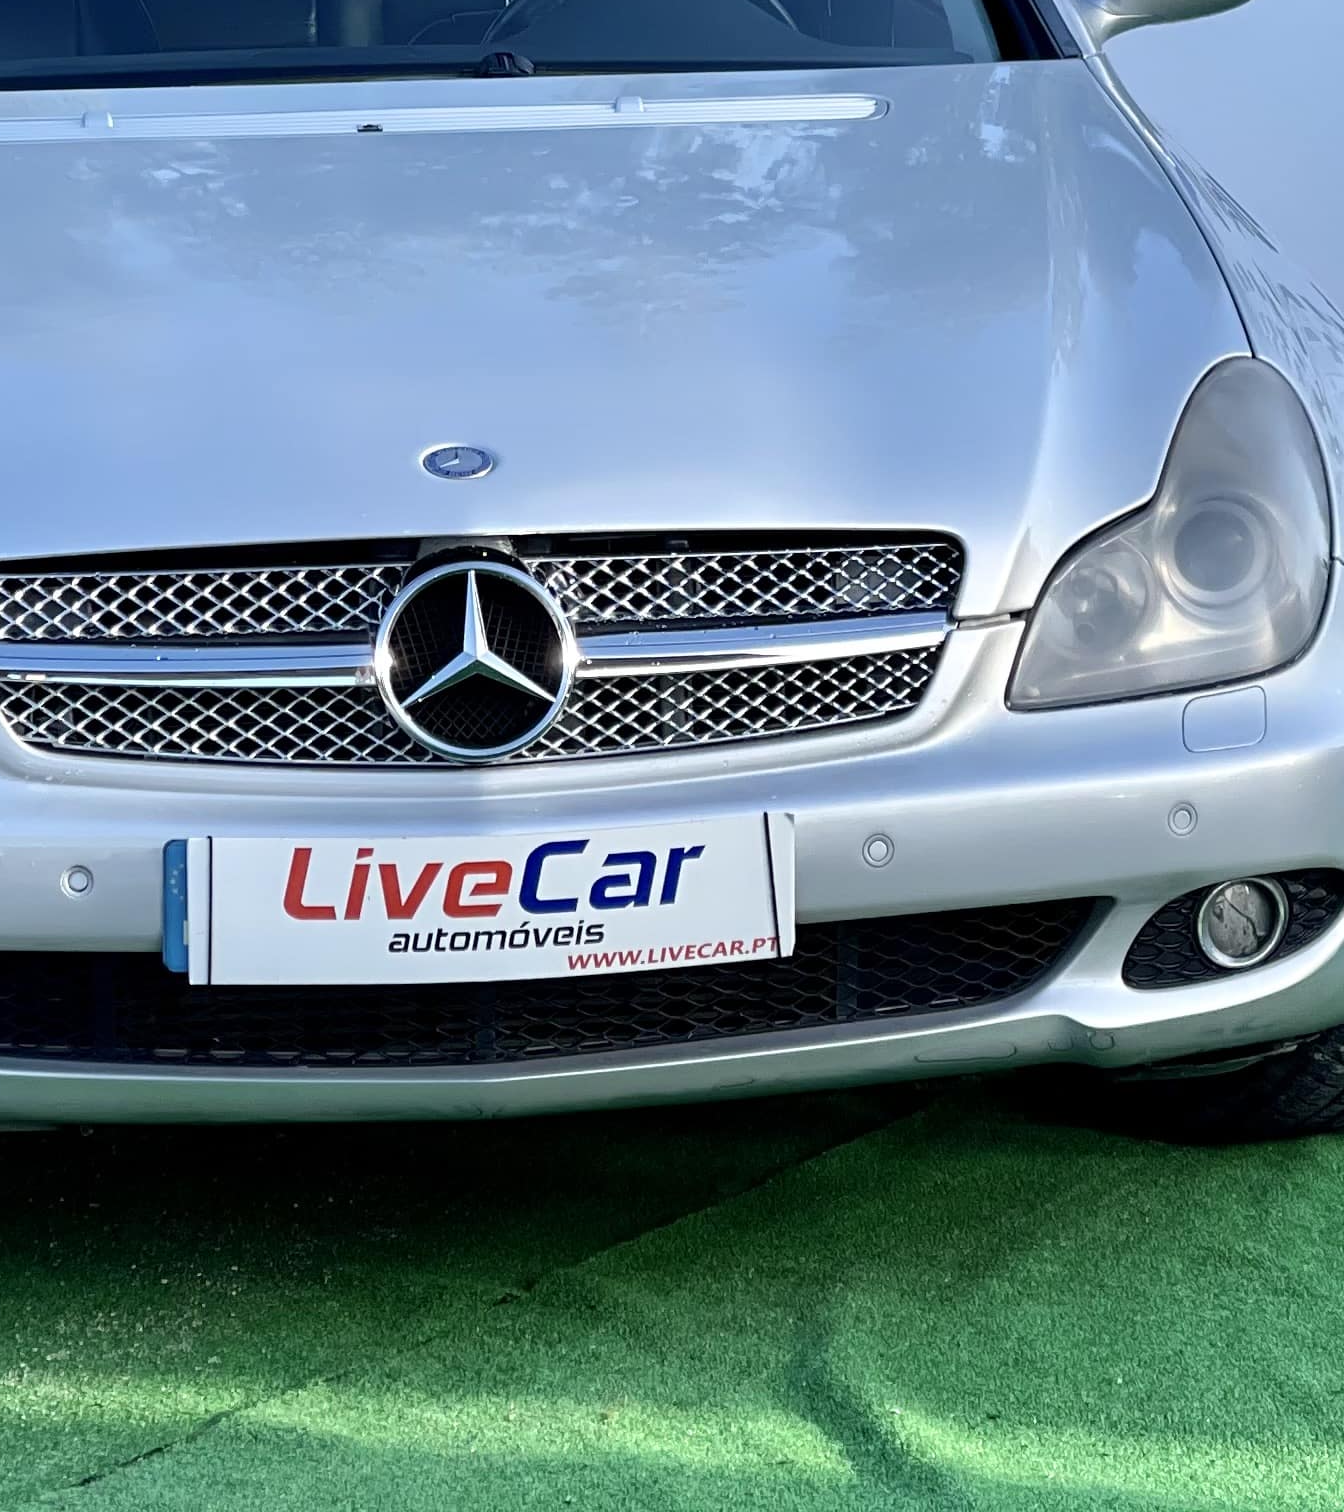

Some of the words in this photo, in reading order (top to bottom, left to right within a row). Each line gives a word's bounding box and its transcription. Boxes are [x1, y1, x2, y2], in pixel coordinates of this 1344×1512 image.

[282, 839, 706, 921] LiveCar
[388, 919, 605, 953] automóveis
[567, 936, 781, 971] WWW.LIVECAR.PT
